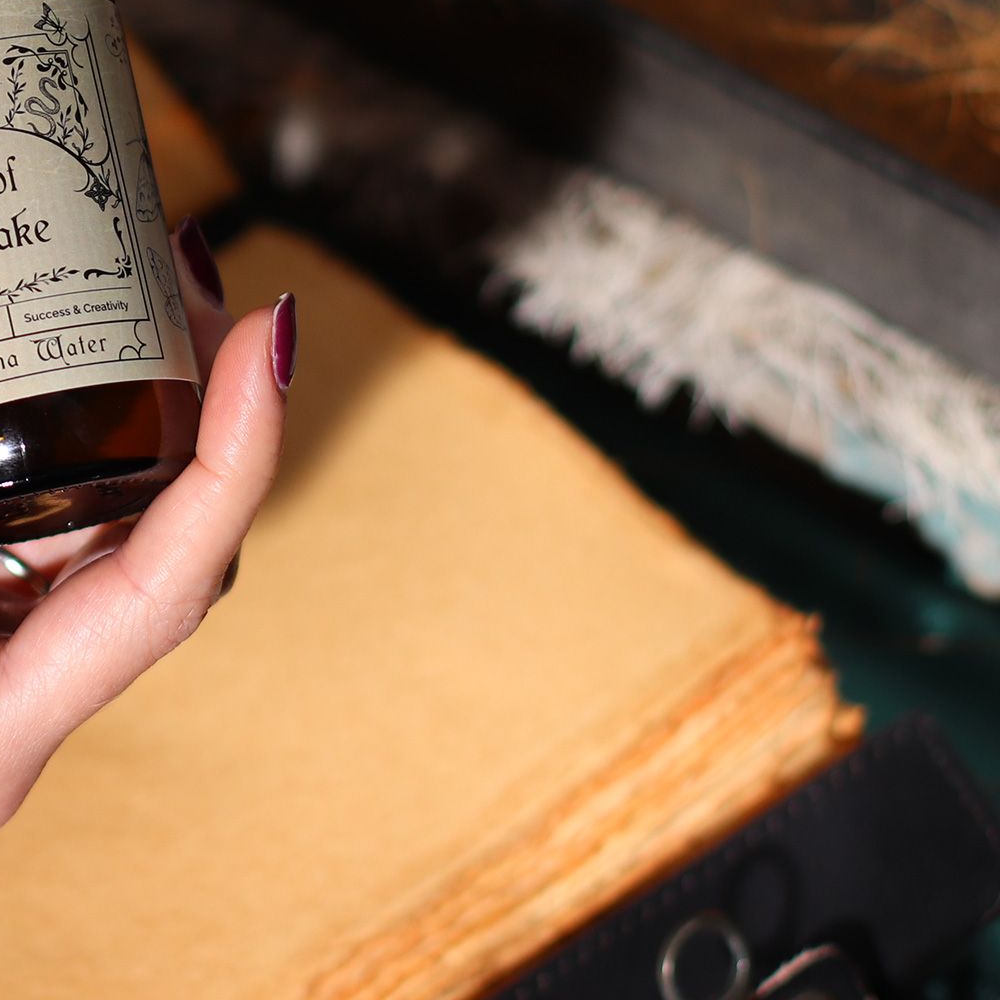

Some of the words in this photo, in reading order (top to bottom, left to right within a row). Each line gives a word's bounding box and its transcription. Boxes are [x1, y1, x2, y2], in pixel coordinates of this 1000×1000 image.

[23, 308, 71, 323] Success
[73, 306, 82, 315] &
[83, 300, 129, 313] Creativity
[29, 334, 107, 366] Water
